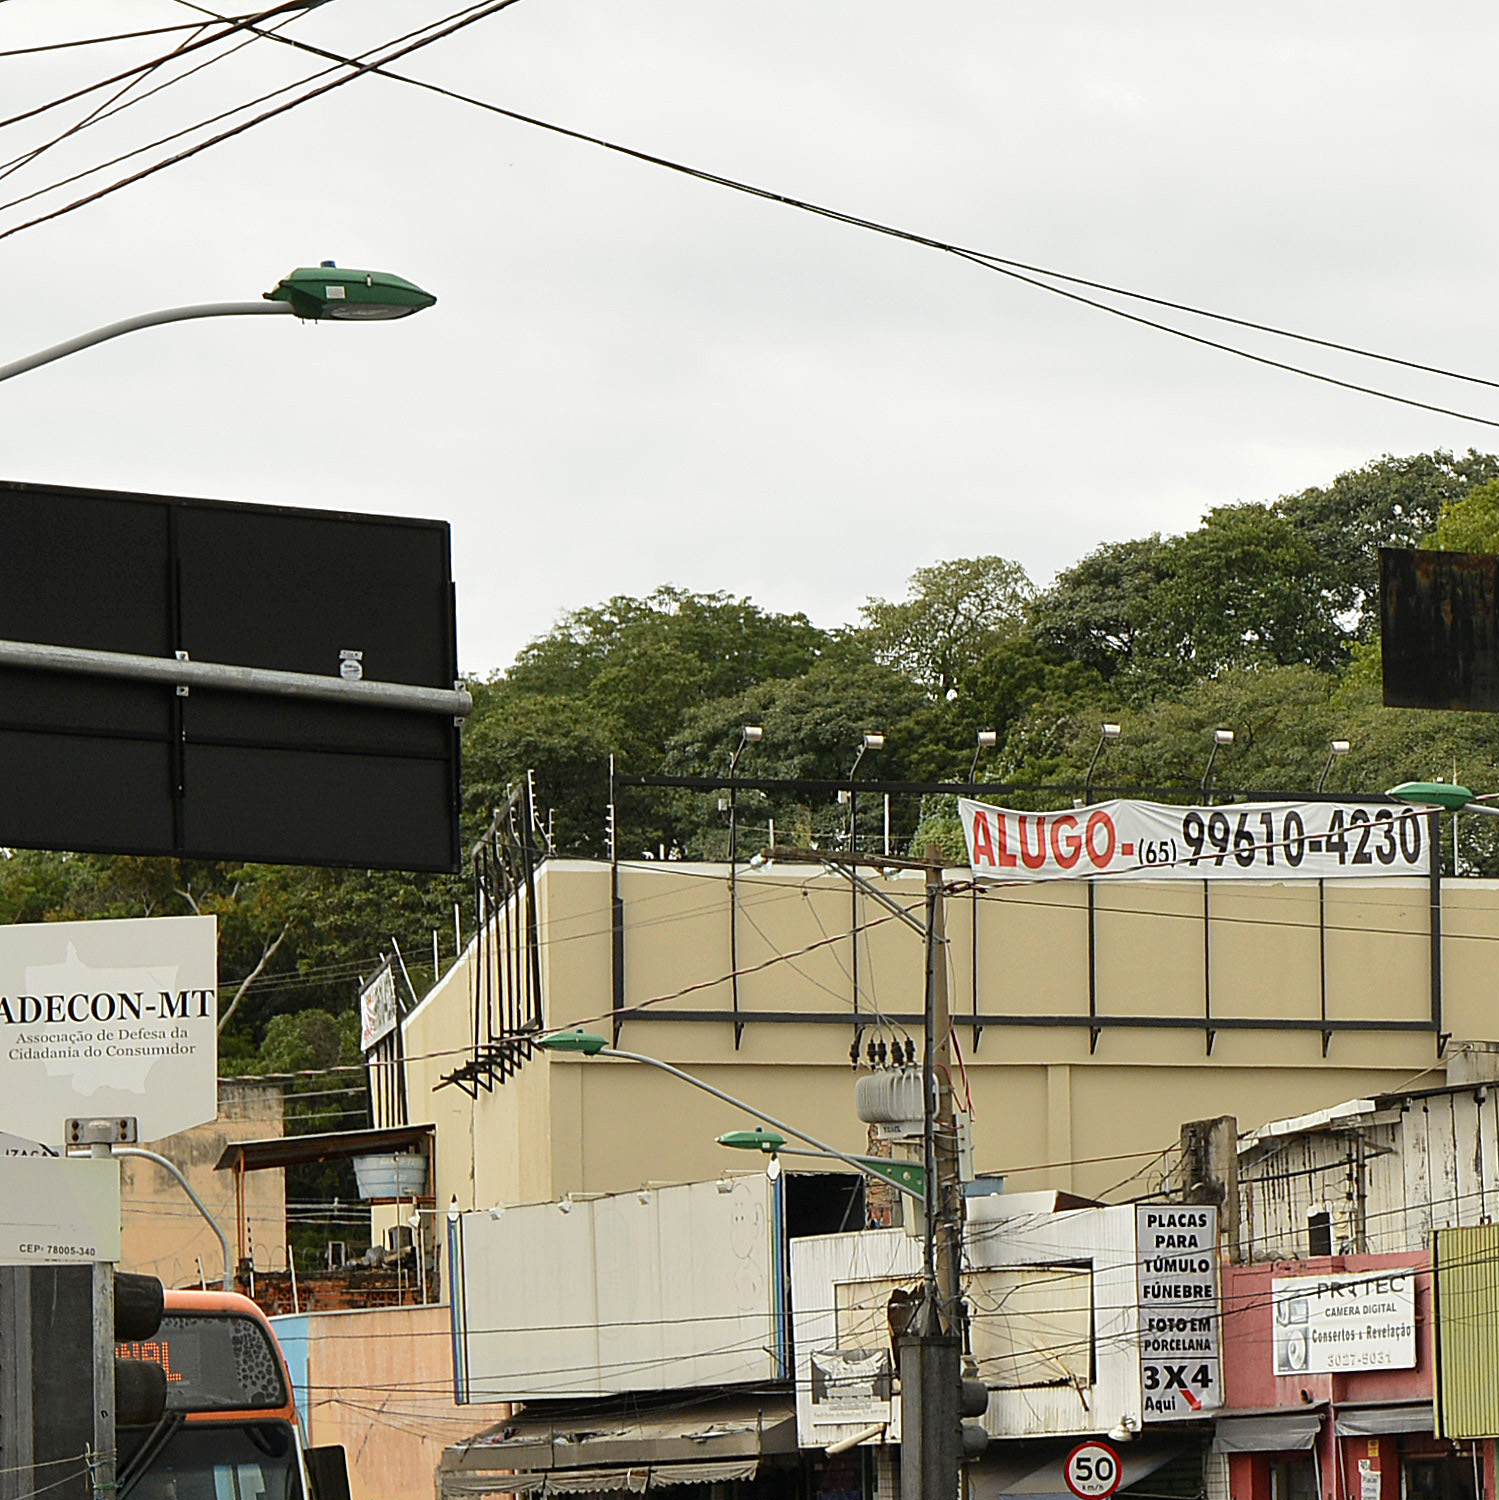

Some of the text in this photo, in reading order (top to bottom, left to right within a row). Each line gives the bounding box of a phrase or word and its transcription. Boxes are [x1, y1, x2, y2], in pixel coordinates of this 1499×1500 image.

[1138, 837, 1177, 867] (65)
[1182, 807, 1420, 868] 99610-4230
[0, 989, 215, 1025] ADECON-MT
[16, 1027, 188, 1045] Associação de Defesa da
[9, 1043, 196, 1060] Cidadania do Consumidor
[1148, 1213, 1207, 1228] PLACAS
[1155, 1235, 1198, 1248] PARA
[47, 1245, 96, 1256] 78005-340
[1144, 1255, 1210, 1273] TÚMULO
[1143, 1281, 1212, 1299] FÚNEBRE
[1325, 1303, 1397, 1317] CAMERA DIGITAL
[1148, 1317, 1211, 1332] FOTO EM
[1312, 1329, 1355, 1343] Consertos
[1366, 1323, 1411, 1341] Revelação
[1144, 1339, 1211, 1351] PORCELANA
[1145, 1396, 1176, 1413] Aqui
[1076, 1457, 1113, 1481] 50
